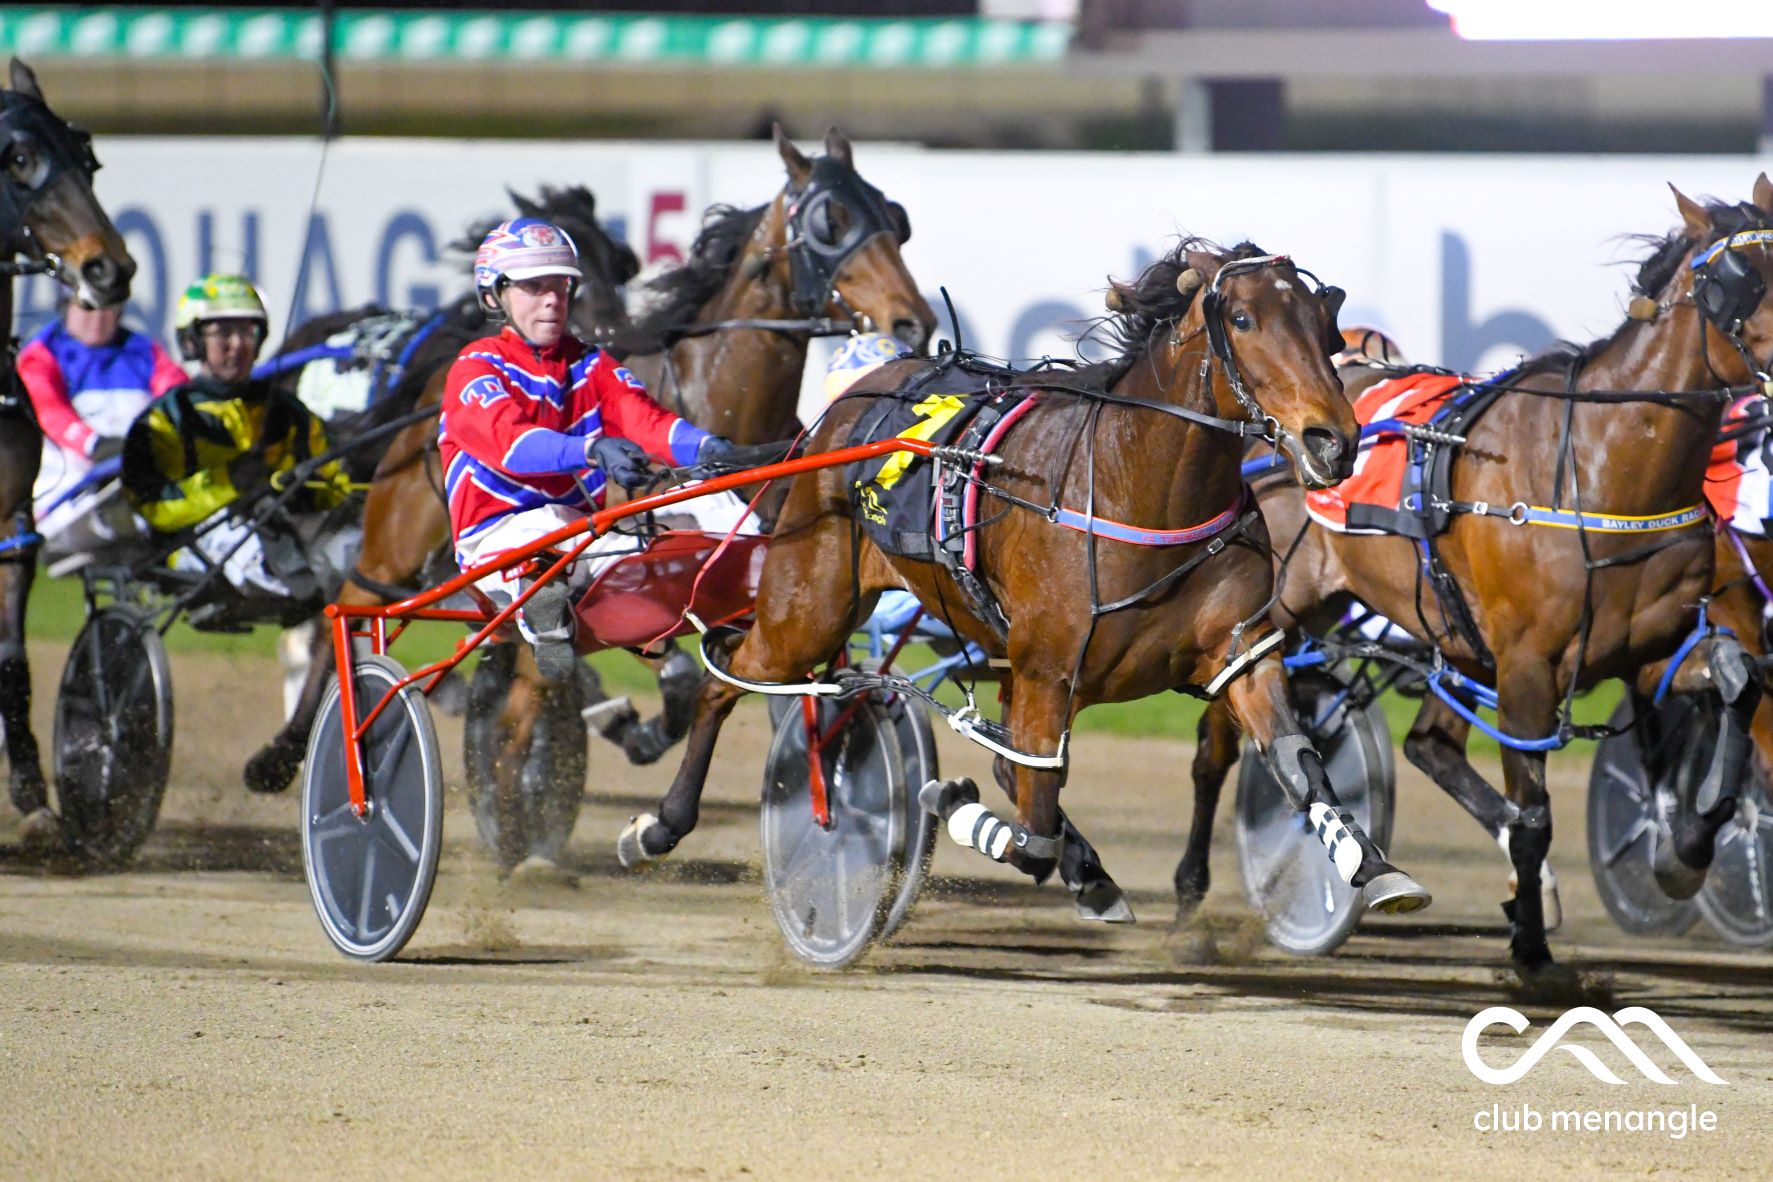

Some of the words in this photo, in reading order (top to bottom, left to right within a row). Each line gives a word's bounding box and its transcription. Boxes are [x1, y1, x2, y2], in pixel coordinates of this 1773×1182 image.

[875, 394, 965, 490] 7
[1602, 518, 1644, 530] BAYLEY
[1648, 516, 1678, 529] DUCK
